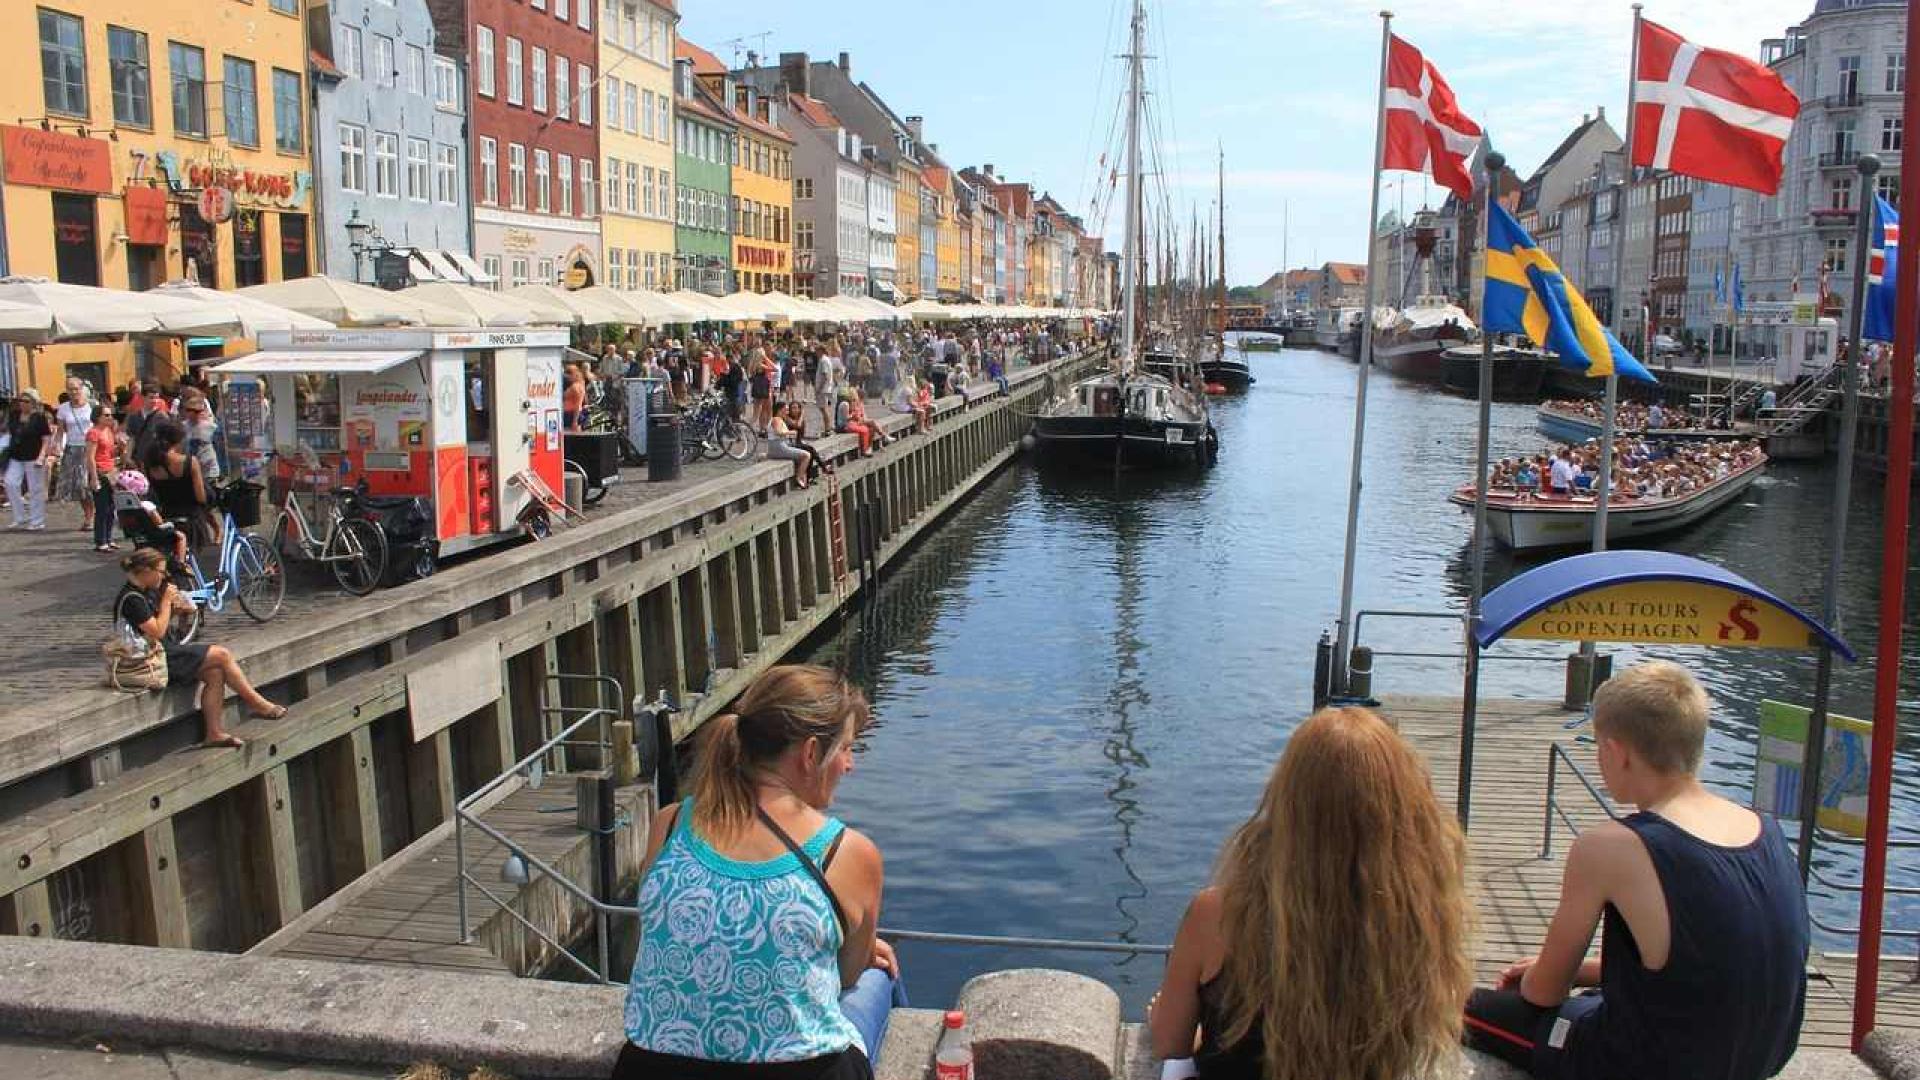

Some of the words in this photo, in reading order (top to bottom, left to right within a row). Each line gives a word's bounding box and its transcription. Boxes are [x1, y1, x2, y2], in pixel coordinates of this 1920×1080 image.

[1544, 601, 1620, 616] CANAL
[1625, 602, 1700, 619] TOURS
[1541, 620, 1700, 638] COPENHAGEN
